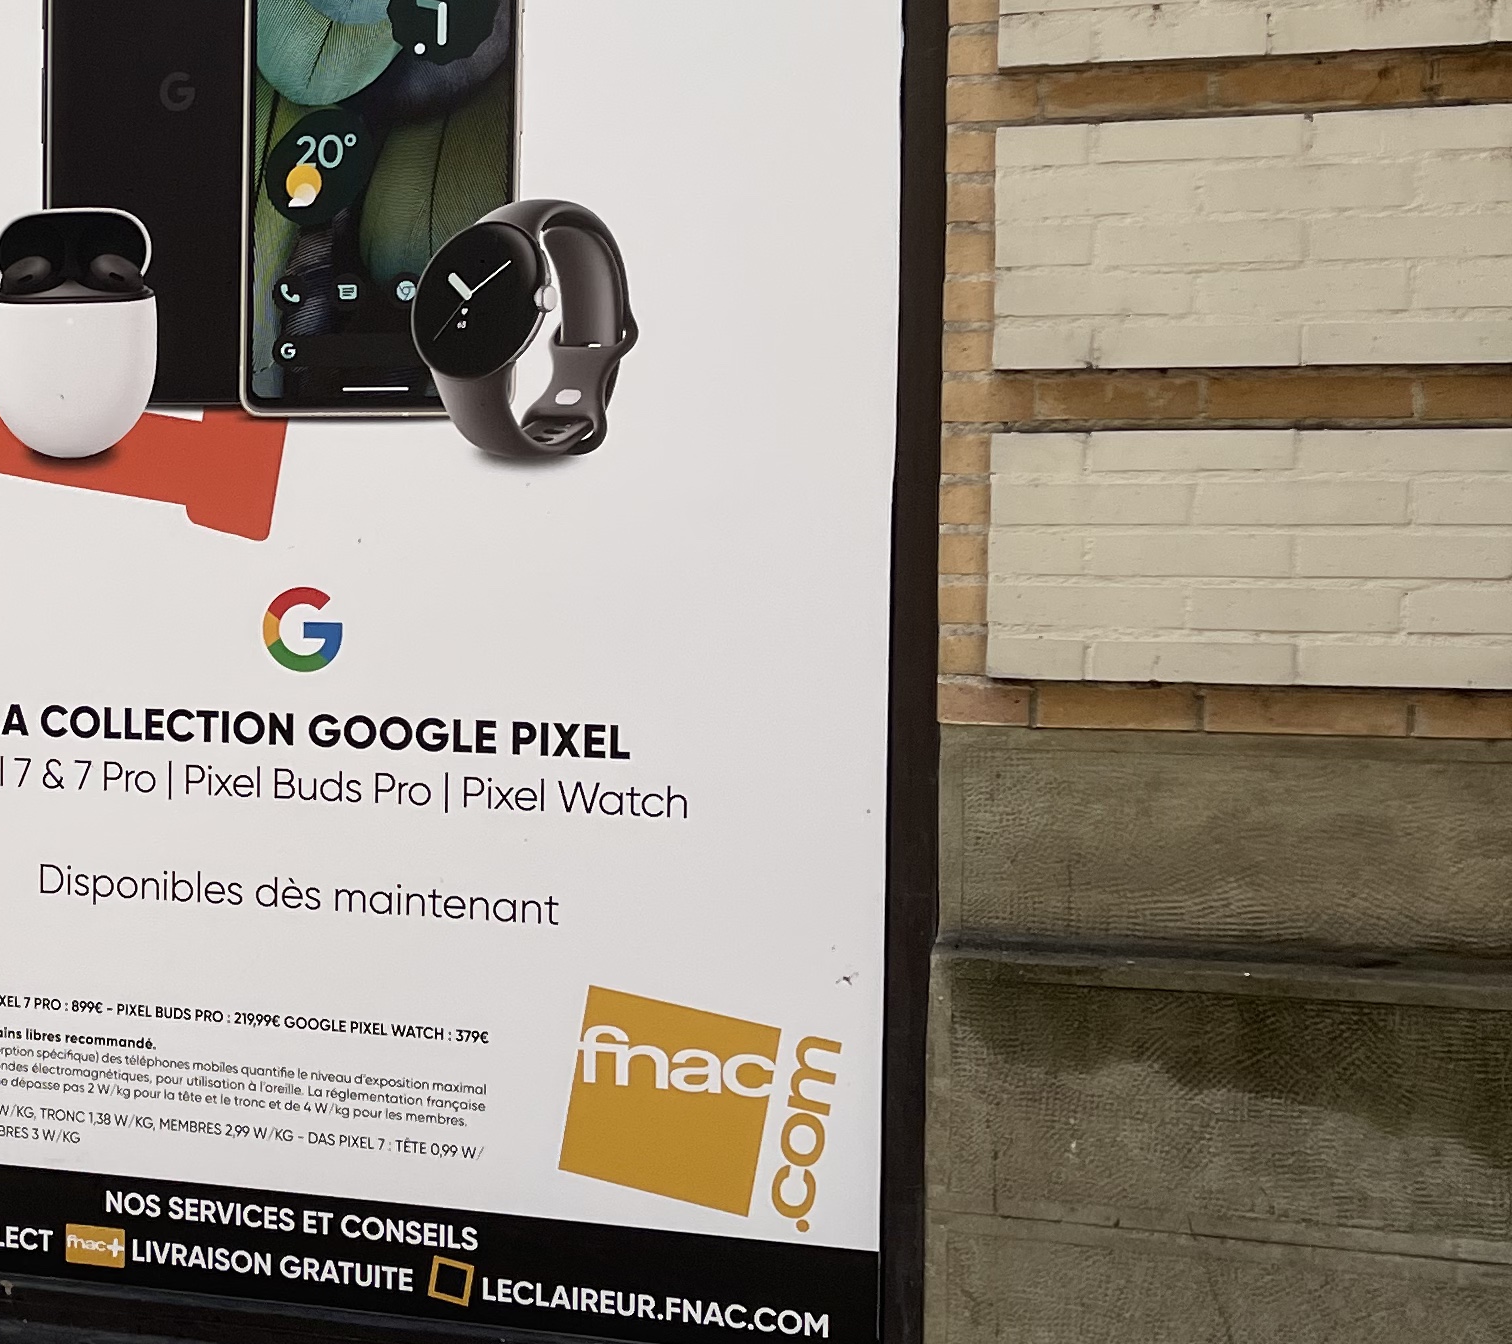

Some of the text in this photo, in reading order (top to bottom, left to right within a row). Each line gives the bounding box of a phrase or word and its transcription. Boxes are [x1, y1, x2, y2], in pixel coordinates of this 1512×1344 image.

[39, 703, 295, 746] COLLECTION
[307, 713, 497, 755] GOOGLE
[511, 720, 631, 760] PIXEL
[13, 756, 32, 788] 7
[41, 757, 65, 790] &
[73, 758, 93, 791] 7
[102, 759, 157, 794] Pro
[184, 763, 261, 798] Pixel
[273, 767, 362, 804] Buds
[373, 771, 432, 807] Pro
[462, 775, 545, 812] Pixel
[556, 779, 688, 819] Watch
[39, 862, 560, 926] Disponibles dès maintenant
[23, 996, 31, 1009] 7
[33, 996, 62, 1011] PRO
[71, 999, 103, 1014] 899€
[116, 1002, 153, 1018] PIXEL
[155, 1005, 192, 1021] BUDS
[194, 1008, 224, 1023] PRO
[233, 1011, 281, 1029] 219,99€
[283, 1015, 347, 1033] GOOGLE
[349, 1020, 389, 1036] PIXEL
[390, 1023, 444, 1041] WATCH
[455, 1028, 490, 1045] 379€
[25, 1027, 62, 1043] libres
[64, 1033, 157, 1050] recommandé.
[31, 1062, 152, 1085] électromagnétiques,
[155, 1074, 184, 1086] pour
[186, 1075, 245, 1091] utilisation
[259, 1080, 304, 1096] l'oreille.
[307, 1085, 323, 1098] La
[325, 1087, 423, 1107] réglementation
[426, 1095, 486, 1113] française
[36, 1048, 99, 1064] spécifique)
[101, 1052, 123, 1065] des
[124, 1054, 190, 1070] téléphones
[192, 1060, 239, 1075] mobiles
[240, 1065, 295, 1079] quantifie
[297, 1067, 308, 1080] le
[310, 1069, 352, 1084] niveau
[353, 1073, 430, 1090] d'exposition
[431, 1081, 487, 1096] maximal
[577, 1024, 781, 1097] fnac
[10, 1076, 61, 1091] dépasse
[62, 1082, 85, 1094] pas
[96, 1082, 131, 1100] W/kg
[133, 1088, 162, 1100] pour
[163, 1088, 175, 1101] la
[177, 1090, 202, 1103] tête
[204, 1094, 218, 1105] et
[220, 1093, 231, 1106] le
[233, 1095, 266, 1109] tronc
[268, 1099, 282, 1110] et
[284, 1099, 301, 1112] de
[314, 1101, 350, 1119] W/kg
[352, 1107, 383, 1119] pour
[385, 1107, 403, 1121] les
[405, 1112, 467, 1127] membres.
[31, 1127, 39, 1140] 3
[41, 1128, 81, 1144] W/KG
[39, 1106, 86, 1123] TRONC
[88, 1111, 112, 1126] 1,38
[113, 1113, 156, 1132] W/KG,
[159, 1117, 222, 1136] MEMBRES
[224, 1123, 250, 1139] 2,99
[252, 1126, 294, 1142] W/KG
[307, 1131, 336, 1146] DAS
[338, 1134, 375, 1150] PIXEL
[377, 1137, 385, 1151] 7
[394, 1136, 427, 1155] TÊTE
[430, 1142, 458, 1159] 0,99
[460, 1145, 485, 1160] W/
[771, 1035, 843, 1233] .com
[104, 1189, 479, 1251] NOS SERVICES ET CONSEILS
[131, 1237, 414, 1293] LIVRAISON GRATUITE
[481, 1275, 830, 1339] LECLAIREUR.FNAC.COM
